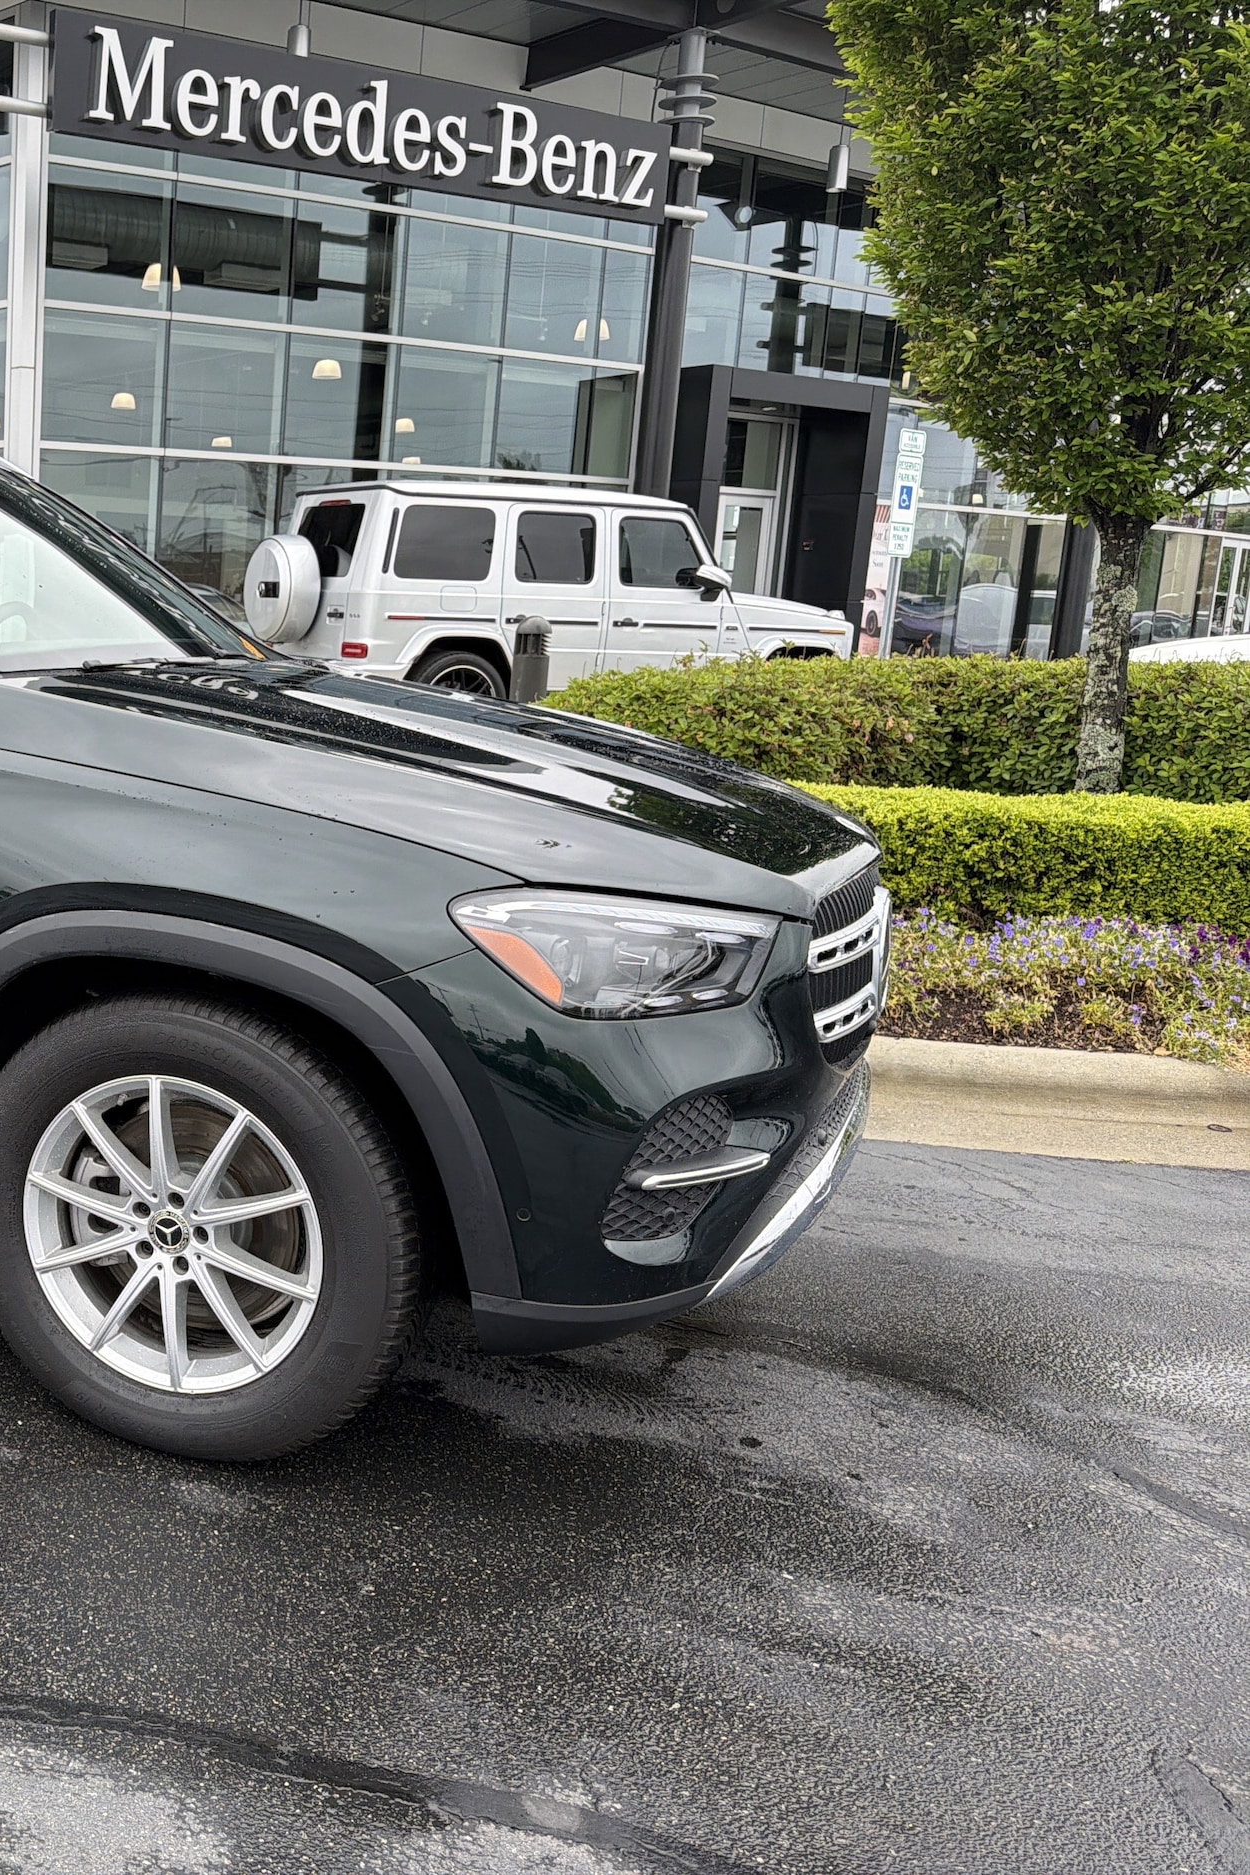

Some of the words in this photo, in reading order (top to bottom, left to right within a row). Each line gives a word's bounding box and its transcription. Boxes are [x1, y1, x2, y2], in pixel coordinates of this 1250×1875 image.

[86, 26, 659, 209] Mercedes-Benz
[898, 460, 921, 472] RESERVED
[898, 472, 918, 484] PARKING
